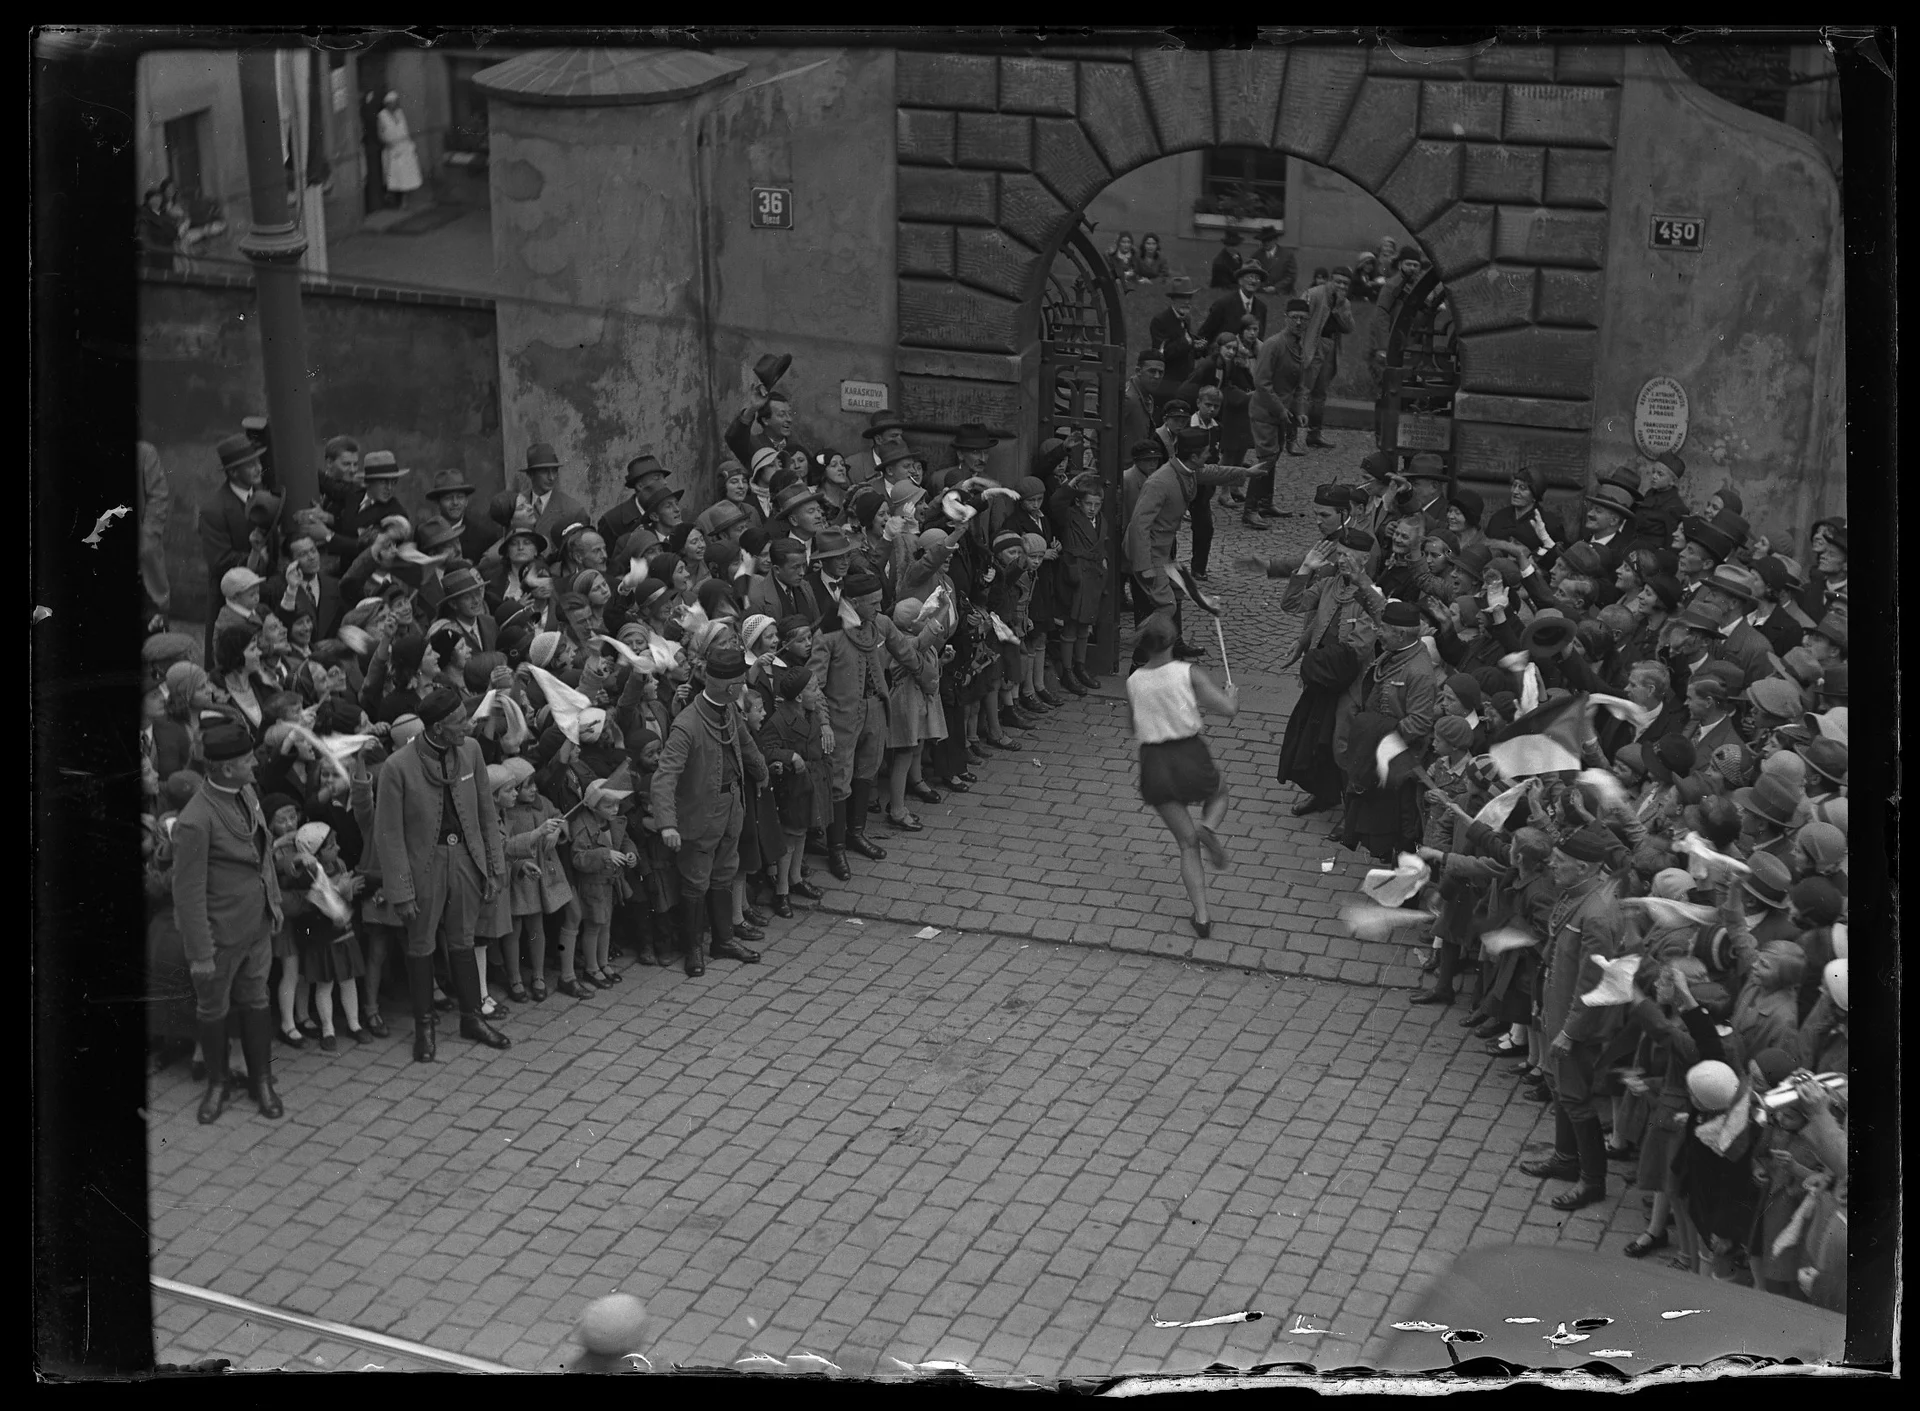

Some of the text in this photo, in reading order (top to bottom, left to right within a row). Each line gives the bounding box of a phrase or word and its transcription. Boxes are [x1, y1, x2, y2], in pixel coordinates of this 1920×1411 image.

[759, 192, 783, 214] 36
[1659, 222, 1696, 240] 450
[848, 398, 881, 409] GALLERIE
